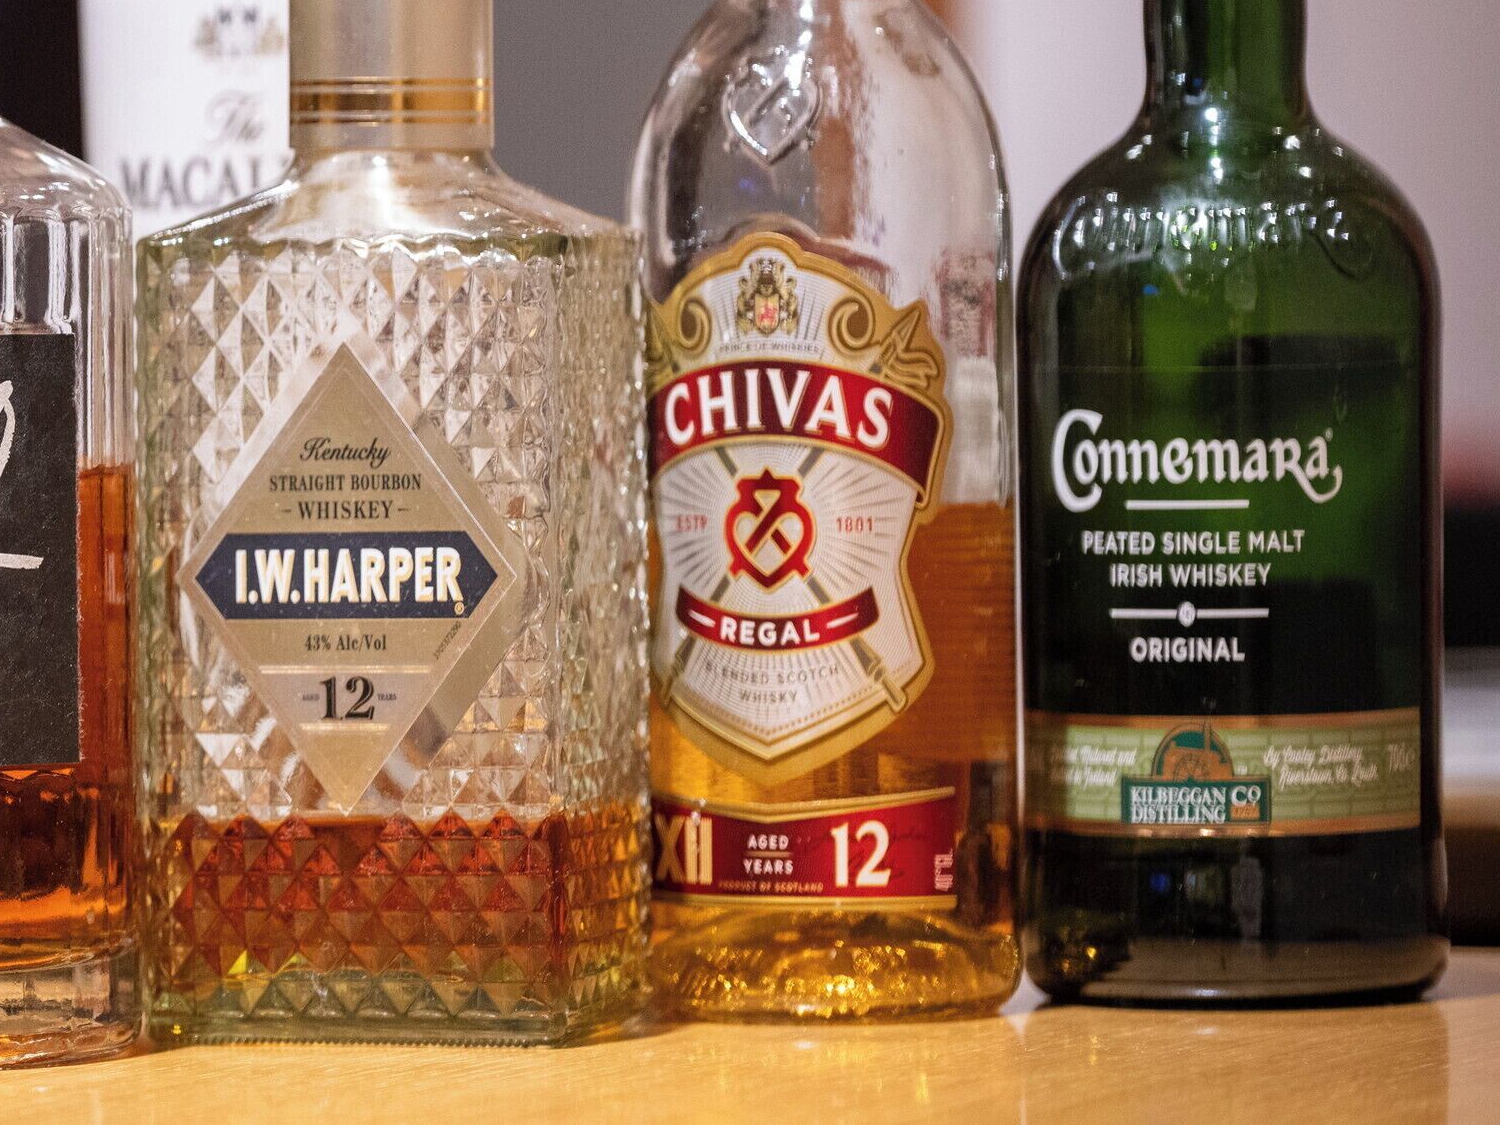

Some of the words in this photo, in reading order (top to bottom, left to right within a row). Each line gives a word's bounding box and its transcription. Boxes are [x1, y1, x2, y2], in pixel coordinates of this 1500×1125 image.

[663, 367, 894, 448] CHIVAS
[300, 437, 392, 467] Kentucky
[1051, 408, 1343, 513] Connemara
[269, 476, 346, 492] STRAIGHT
[350, 474, 422, 491] BOURBON
[298, 500, 395, 520] WHISKEY
[836, 516, 874, 532] 1801
[1081, 531, 1155, 555] PEATED
[1161, 531, 1240, 555] SINGLE
[1248, 529, 1305, 553] MALT
[1109, 563, 1162, 587] IRISH
[1169, 563, 1271, 587] WHISKEY
[720, 615, 820, 647] REGAL
[304, 635, 331, 651] 43%
[336, 634, 387, 652] Alc/Vol
[1130, 637, 1246, 663] ORIGINAL
[705, 662, 770, 685] BLENDED
[779, 665, 839, 683] SCOTCH
[320, 675, 376, 721] 12
[740, 690, 798, 703] WHISKY
[1131, 786, 1226, 806] KILBEGGAN
[1131, 804, 1226, 824] DISTILLING
[654, 815, 713, 885] XII
[748, 835, 789, 849] AGED
[830, 820, 891, 888] 12
[743, 859, 794, 875] YEARS
